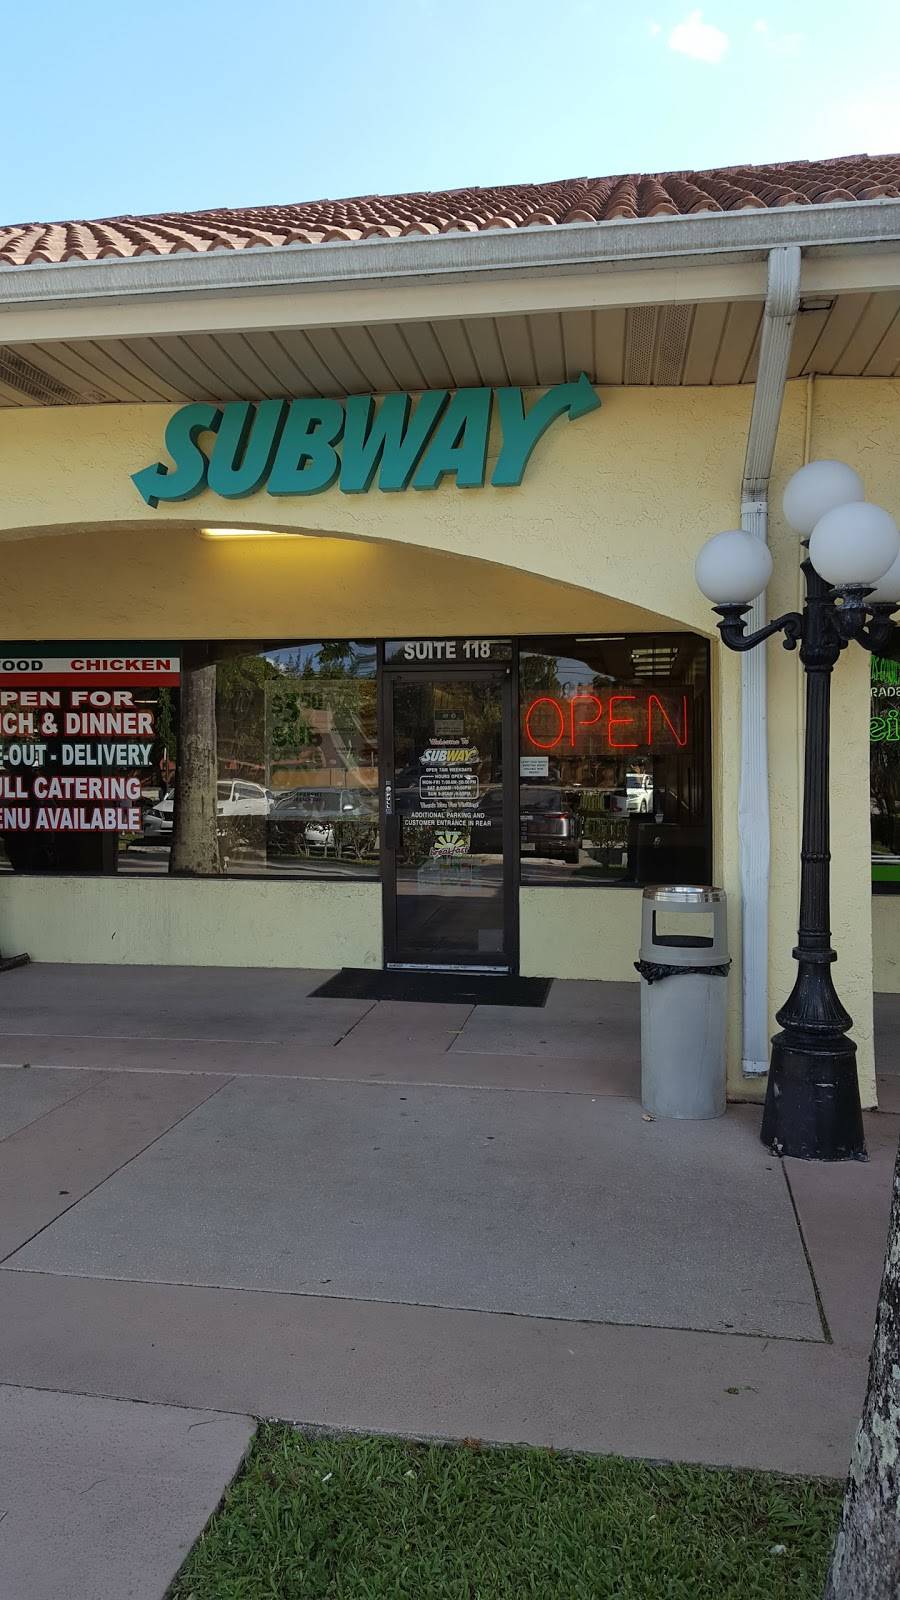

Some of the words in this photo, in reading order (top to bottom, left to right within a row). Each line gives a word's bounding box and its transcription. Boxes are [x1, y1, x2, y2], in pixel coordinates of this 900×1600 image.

[130, 372, 601, 508] SUBWAY
[404, 641, 456, 660] SUITE
[463, 640, 491, 659] 118
[0, 660, 43, 671] OOD
[70, 659, 171, 671] CHICKEN
[71, 691, 134, 706] FOR
[0, 712, 34, 734] CH
[42, 712, 58, 735] &
[66, 712, 154, 735] DINNER
[525, 694, 687, 748] OPEN
[62, 744, 153, 766] DELIVERY
[419, 746, 479, 765] SUBWAY
[34, 776, 141, 800] CATERING
[35, 807, 142, 831] AVAILABLE
